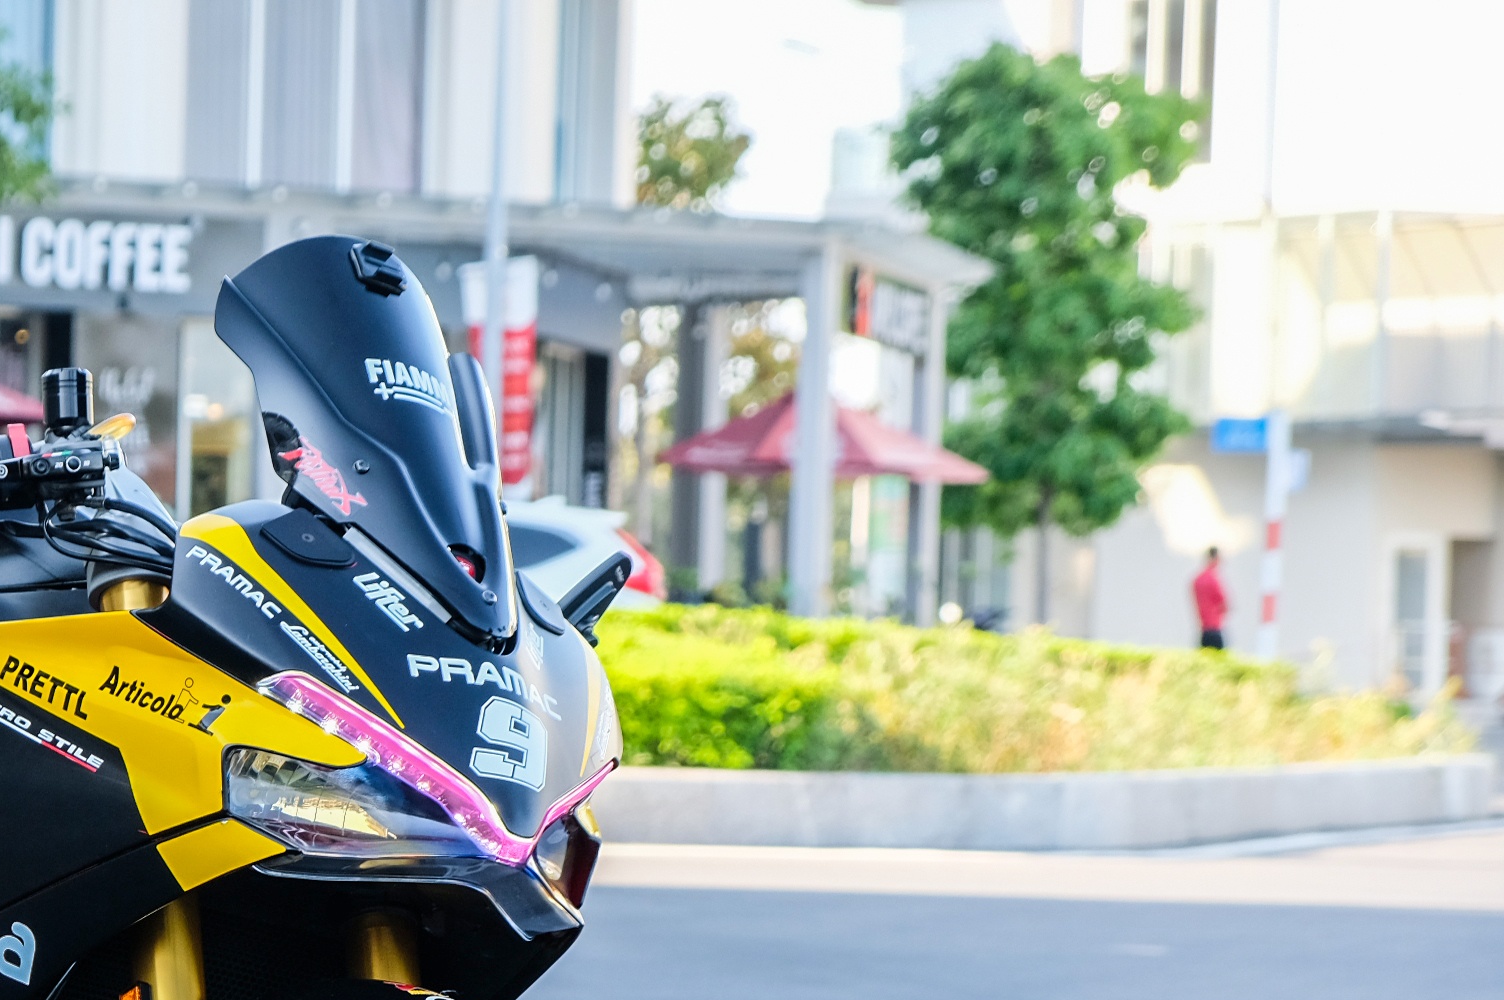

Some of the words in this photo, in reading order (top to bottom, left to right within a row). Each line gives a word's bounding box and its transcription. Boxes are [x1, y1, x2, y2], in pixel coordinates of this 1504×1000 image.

[20, 214, 193, 294] COFFEE
[364, 358, 453, 409] FIAMM
[186, 545, 282, 620] PRAMAC
[353, 572, 424, 632] Lifter
[0, 655, 88, 721] PRETTL
[280, 621, 360, 692] Lamborghini
[406, 653, 562, 722] PRAMAC
[99, 665, 184, 720] Articolo
[37, 729, 104, 770] STILE
